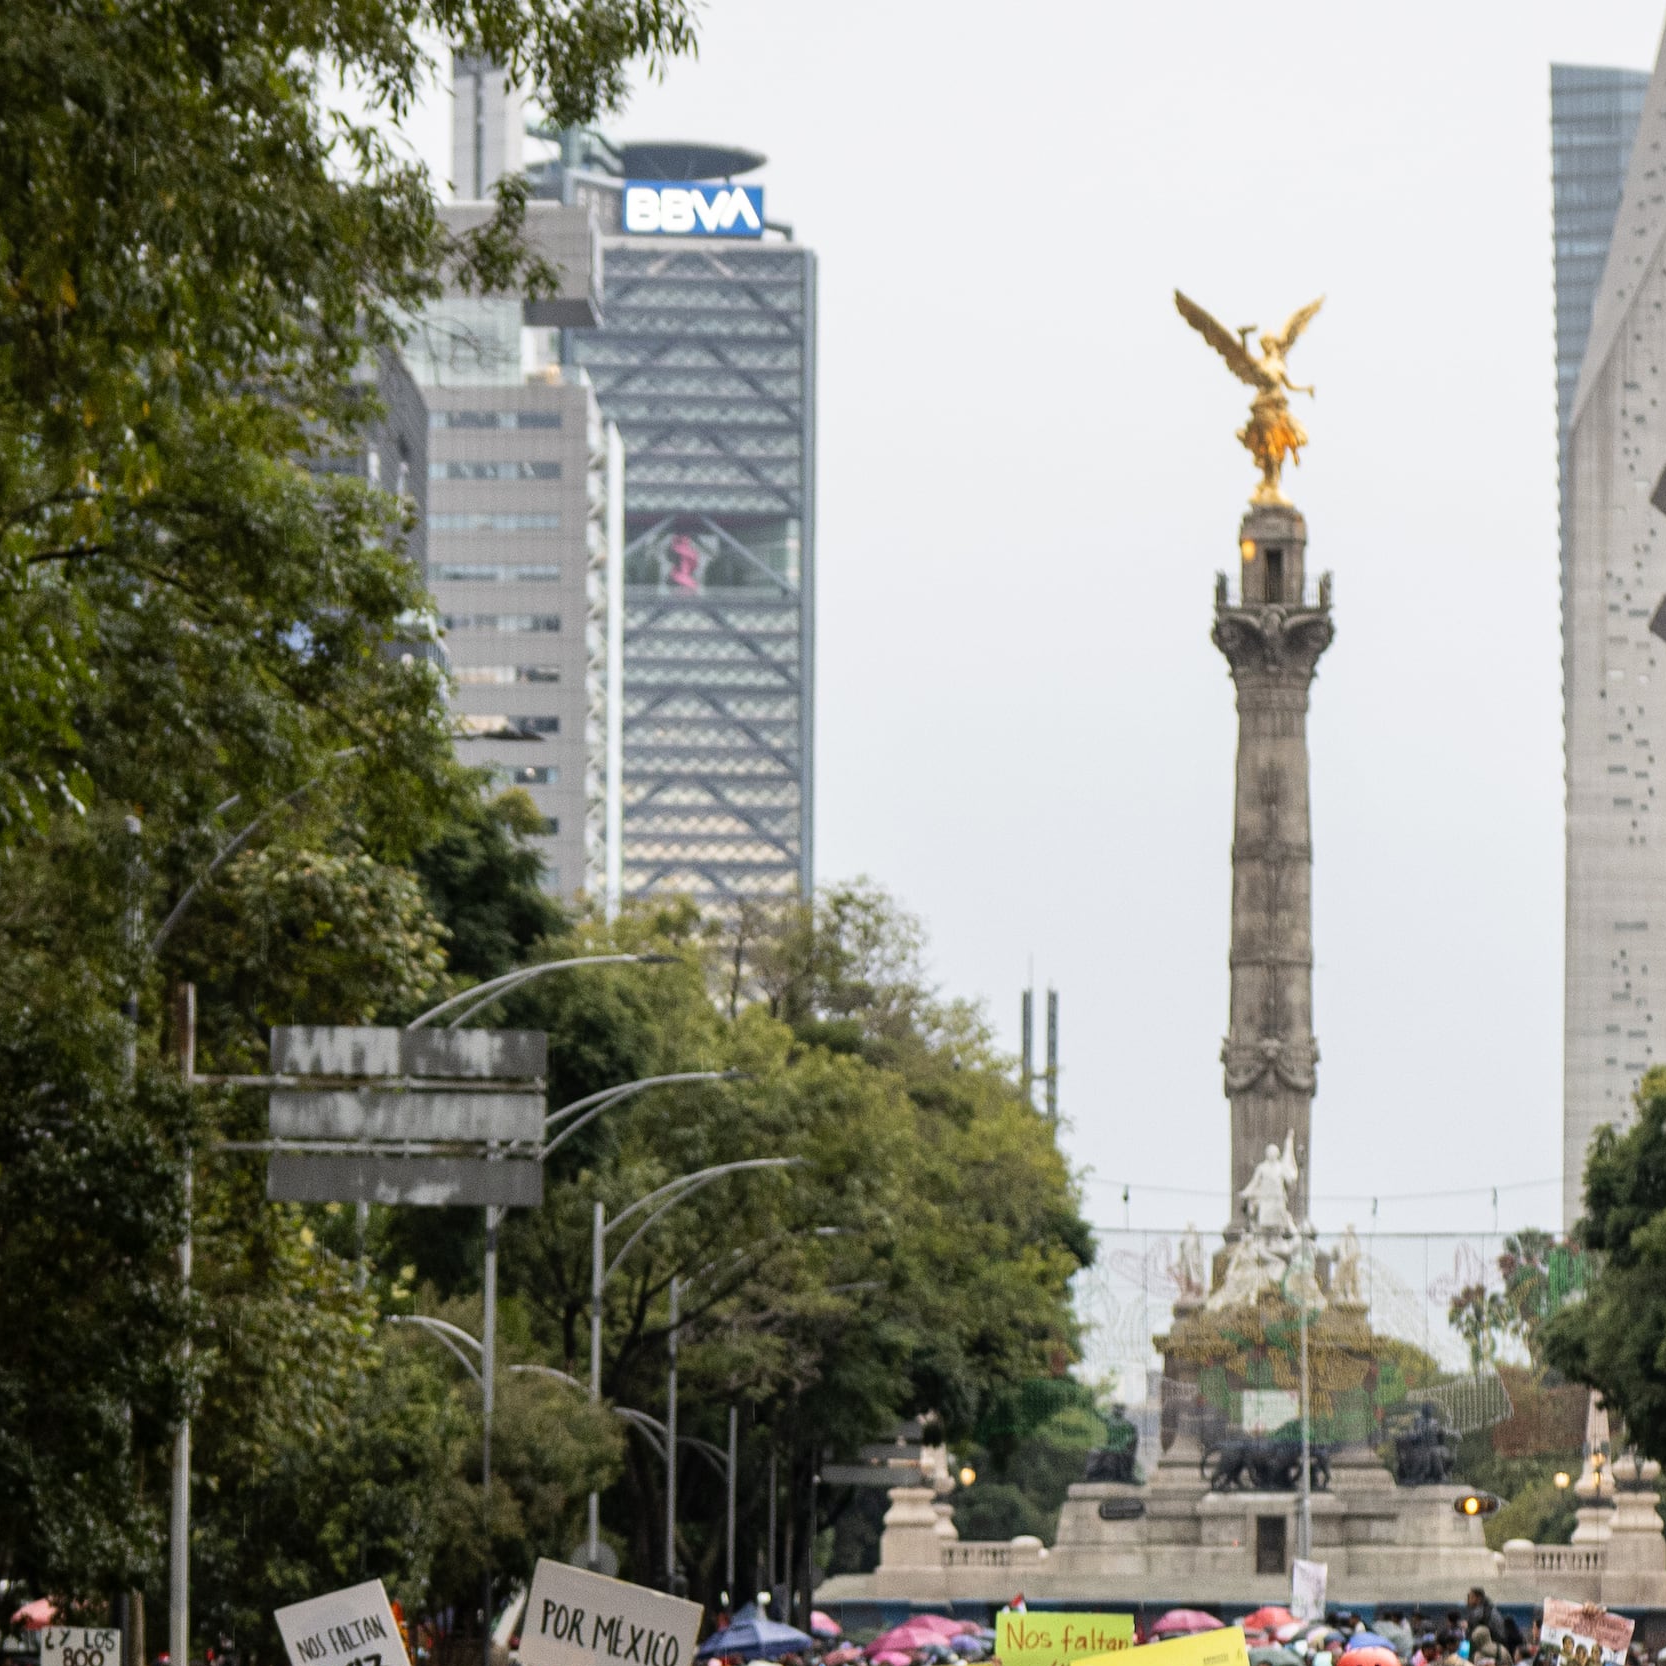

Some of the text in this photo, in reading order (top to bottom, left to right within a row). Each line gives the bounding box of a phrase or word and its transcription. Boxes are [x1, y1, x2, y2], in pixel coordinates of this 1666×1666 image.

[626, 187, 761, 232] BBVA
[85, 1630, 115, 1650] LOS
[296, 1614, 387, 1663] NOS FALTAN
[541, 1599, 584, 1647] POR
[1006, 1621, 1129, 1652] Nos faltan
